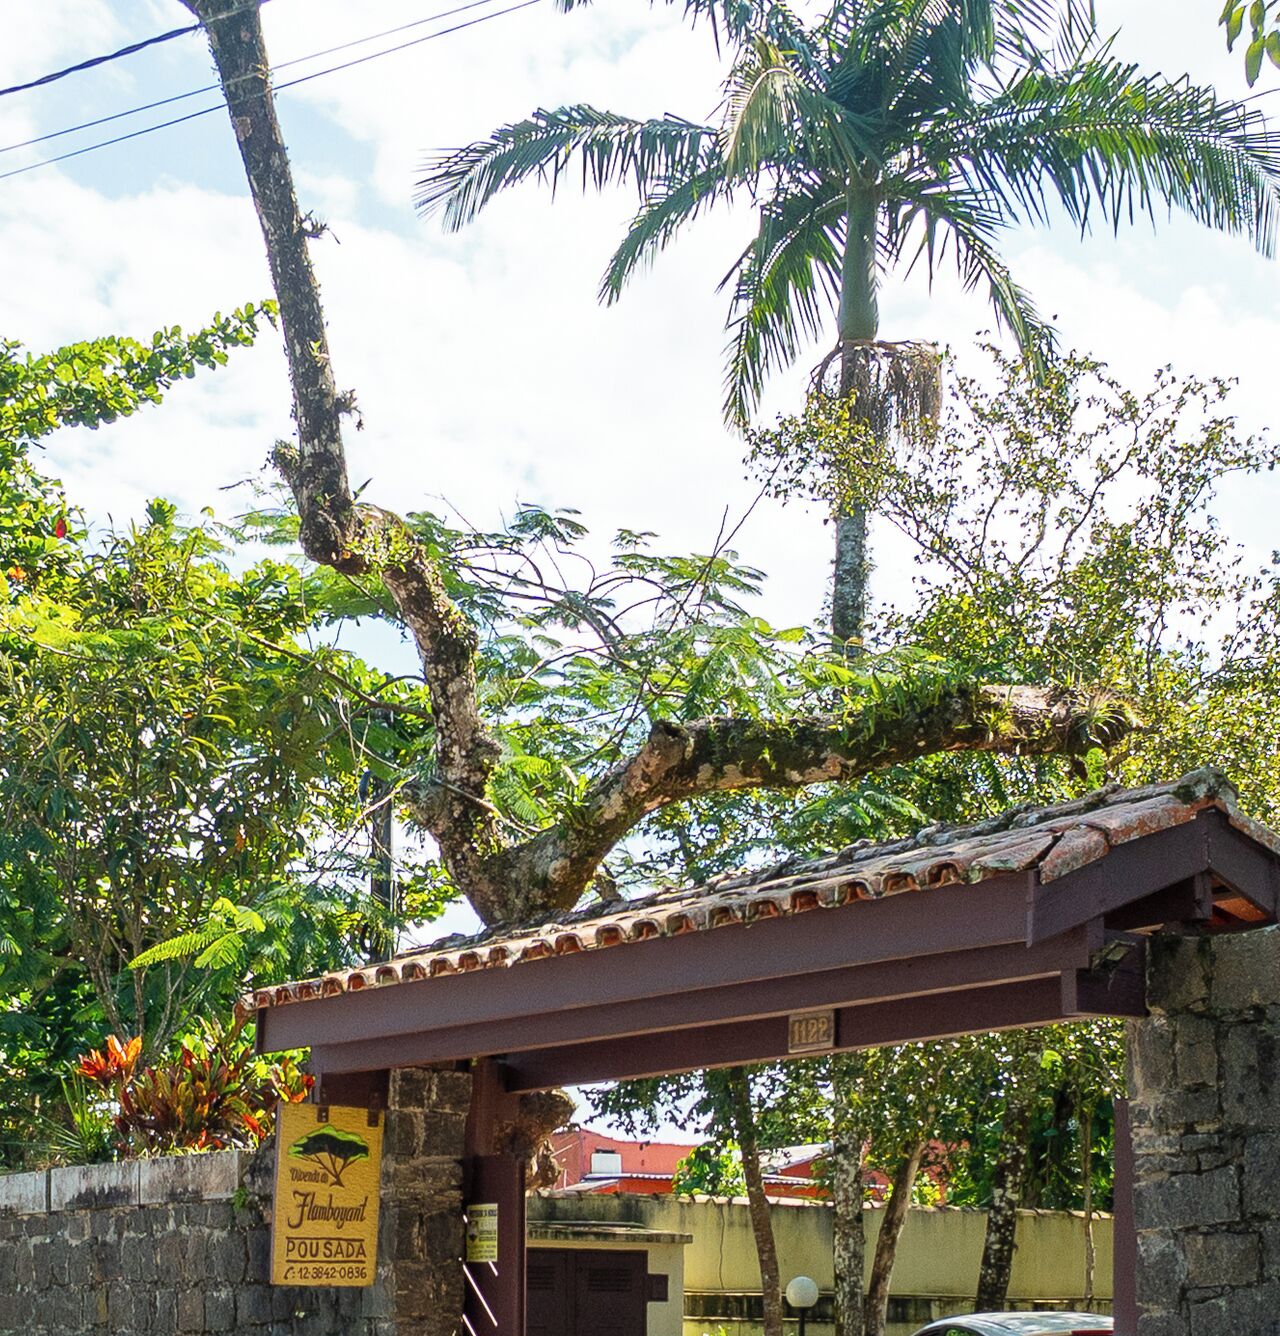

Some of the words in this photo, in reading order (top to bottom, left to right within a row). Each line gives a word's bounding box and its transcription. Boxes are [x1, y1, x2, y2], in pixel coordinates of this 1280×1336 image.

[791, 1017, 830, 1044] 1122
[288, 1190, 368, 1229] Flamboyant
[286, 1240, 367, 1258] POUSADA
